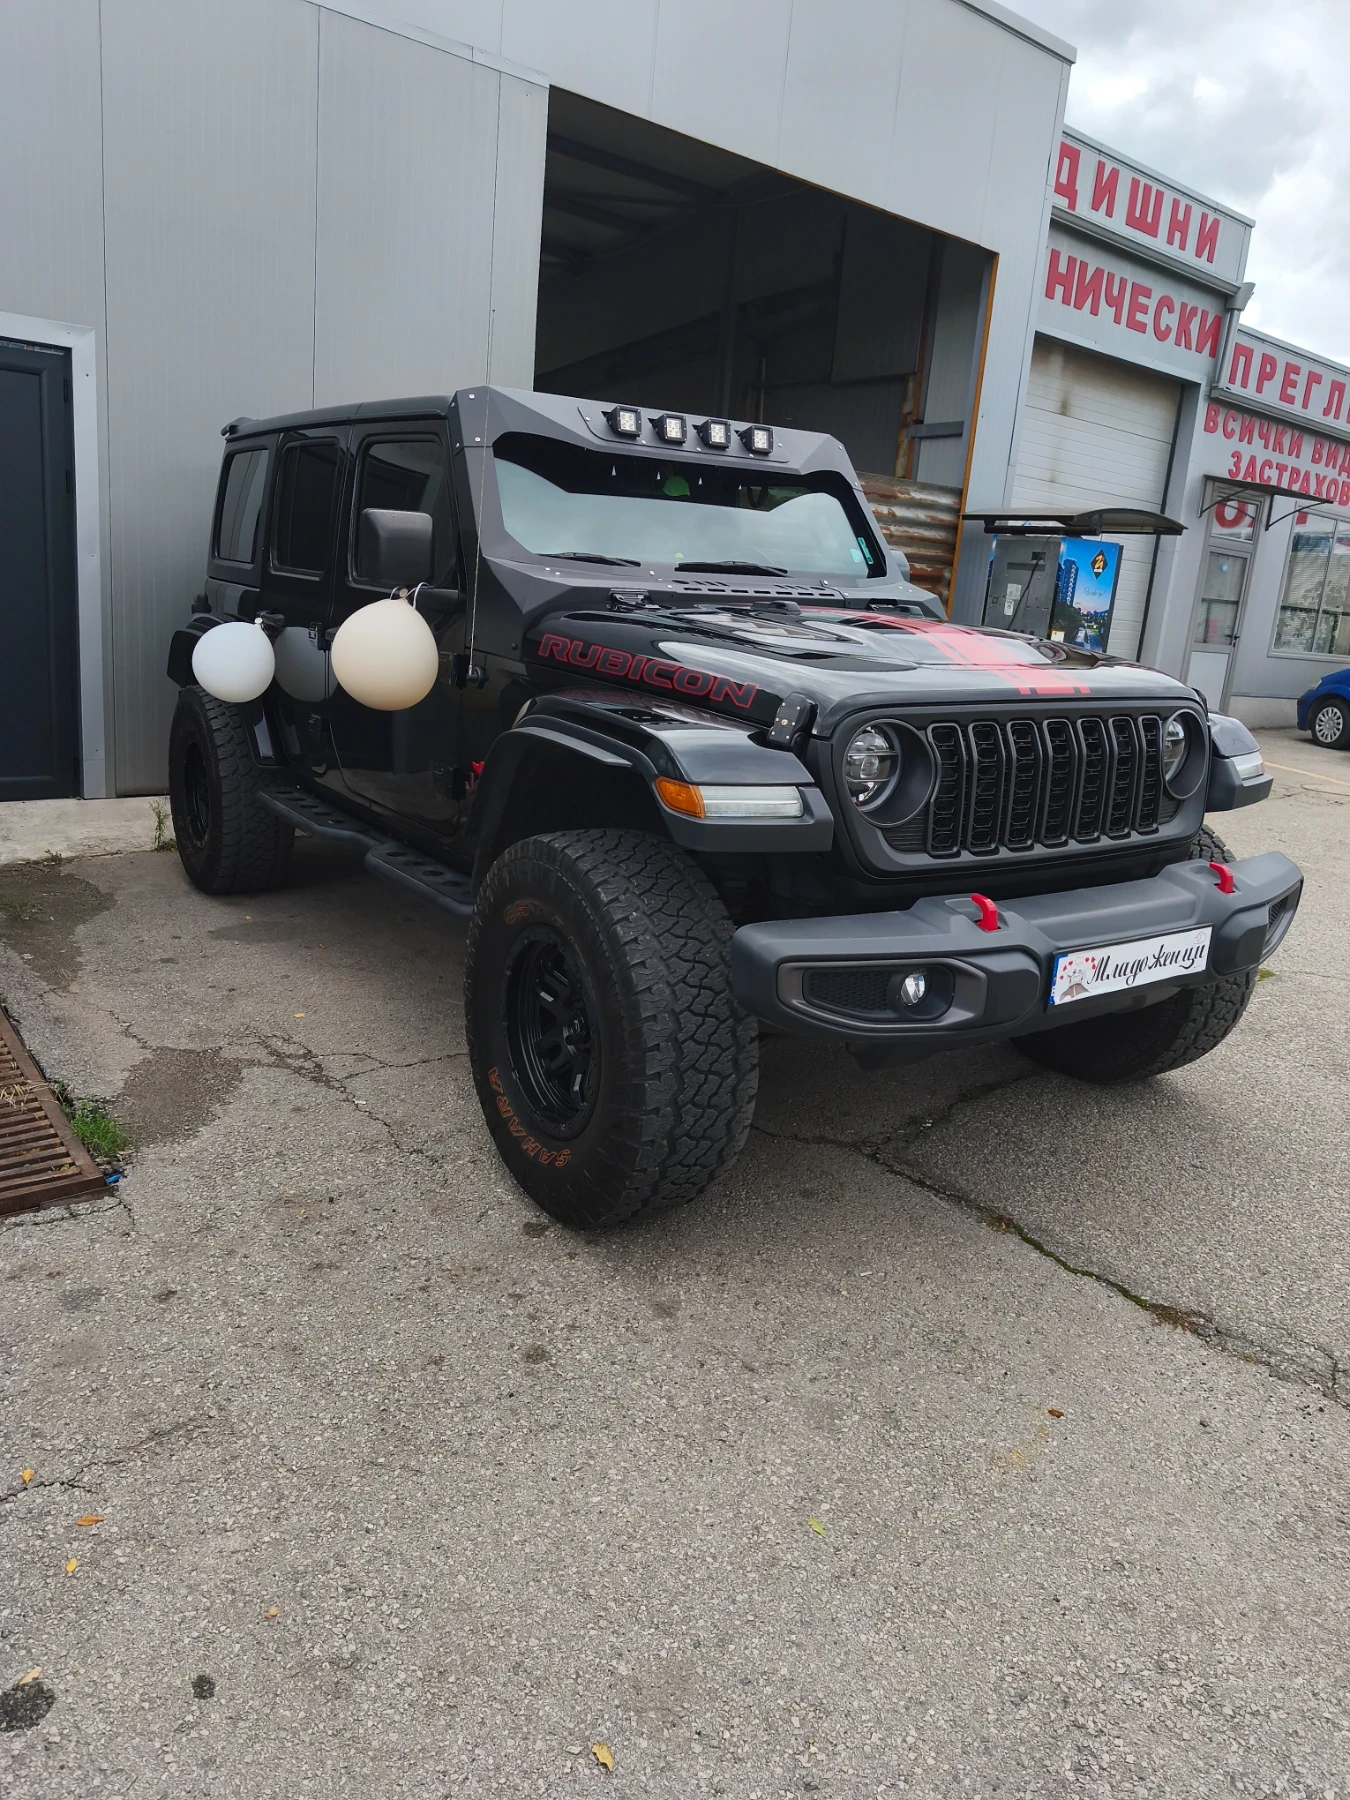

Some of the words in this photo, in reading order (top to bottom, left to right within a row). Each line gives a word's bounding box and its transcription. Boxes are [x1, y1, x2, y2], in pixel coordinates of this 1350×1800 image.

[1044, 247, 1223, 359] НИЧЕСКИ
[1228, 342, 1350, 425] ПРЕГЛ
[1203, 402, 1304, 459] ВСИЧКИ
[538, 633, 759, 709] RUBICON
[488, 1066, 572, 1168] SAHARA
